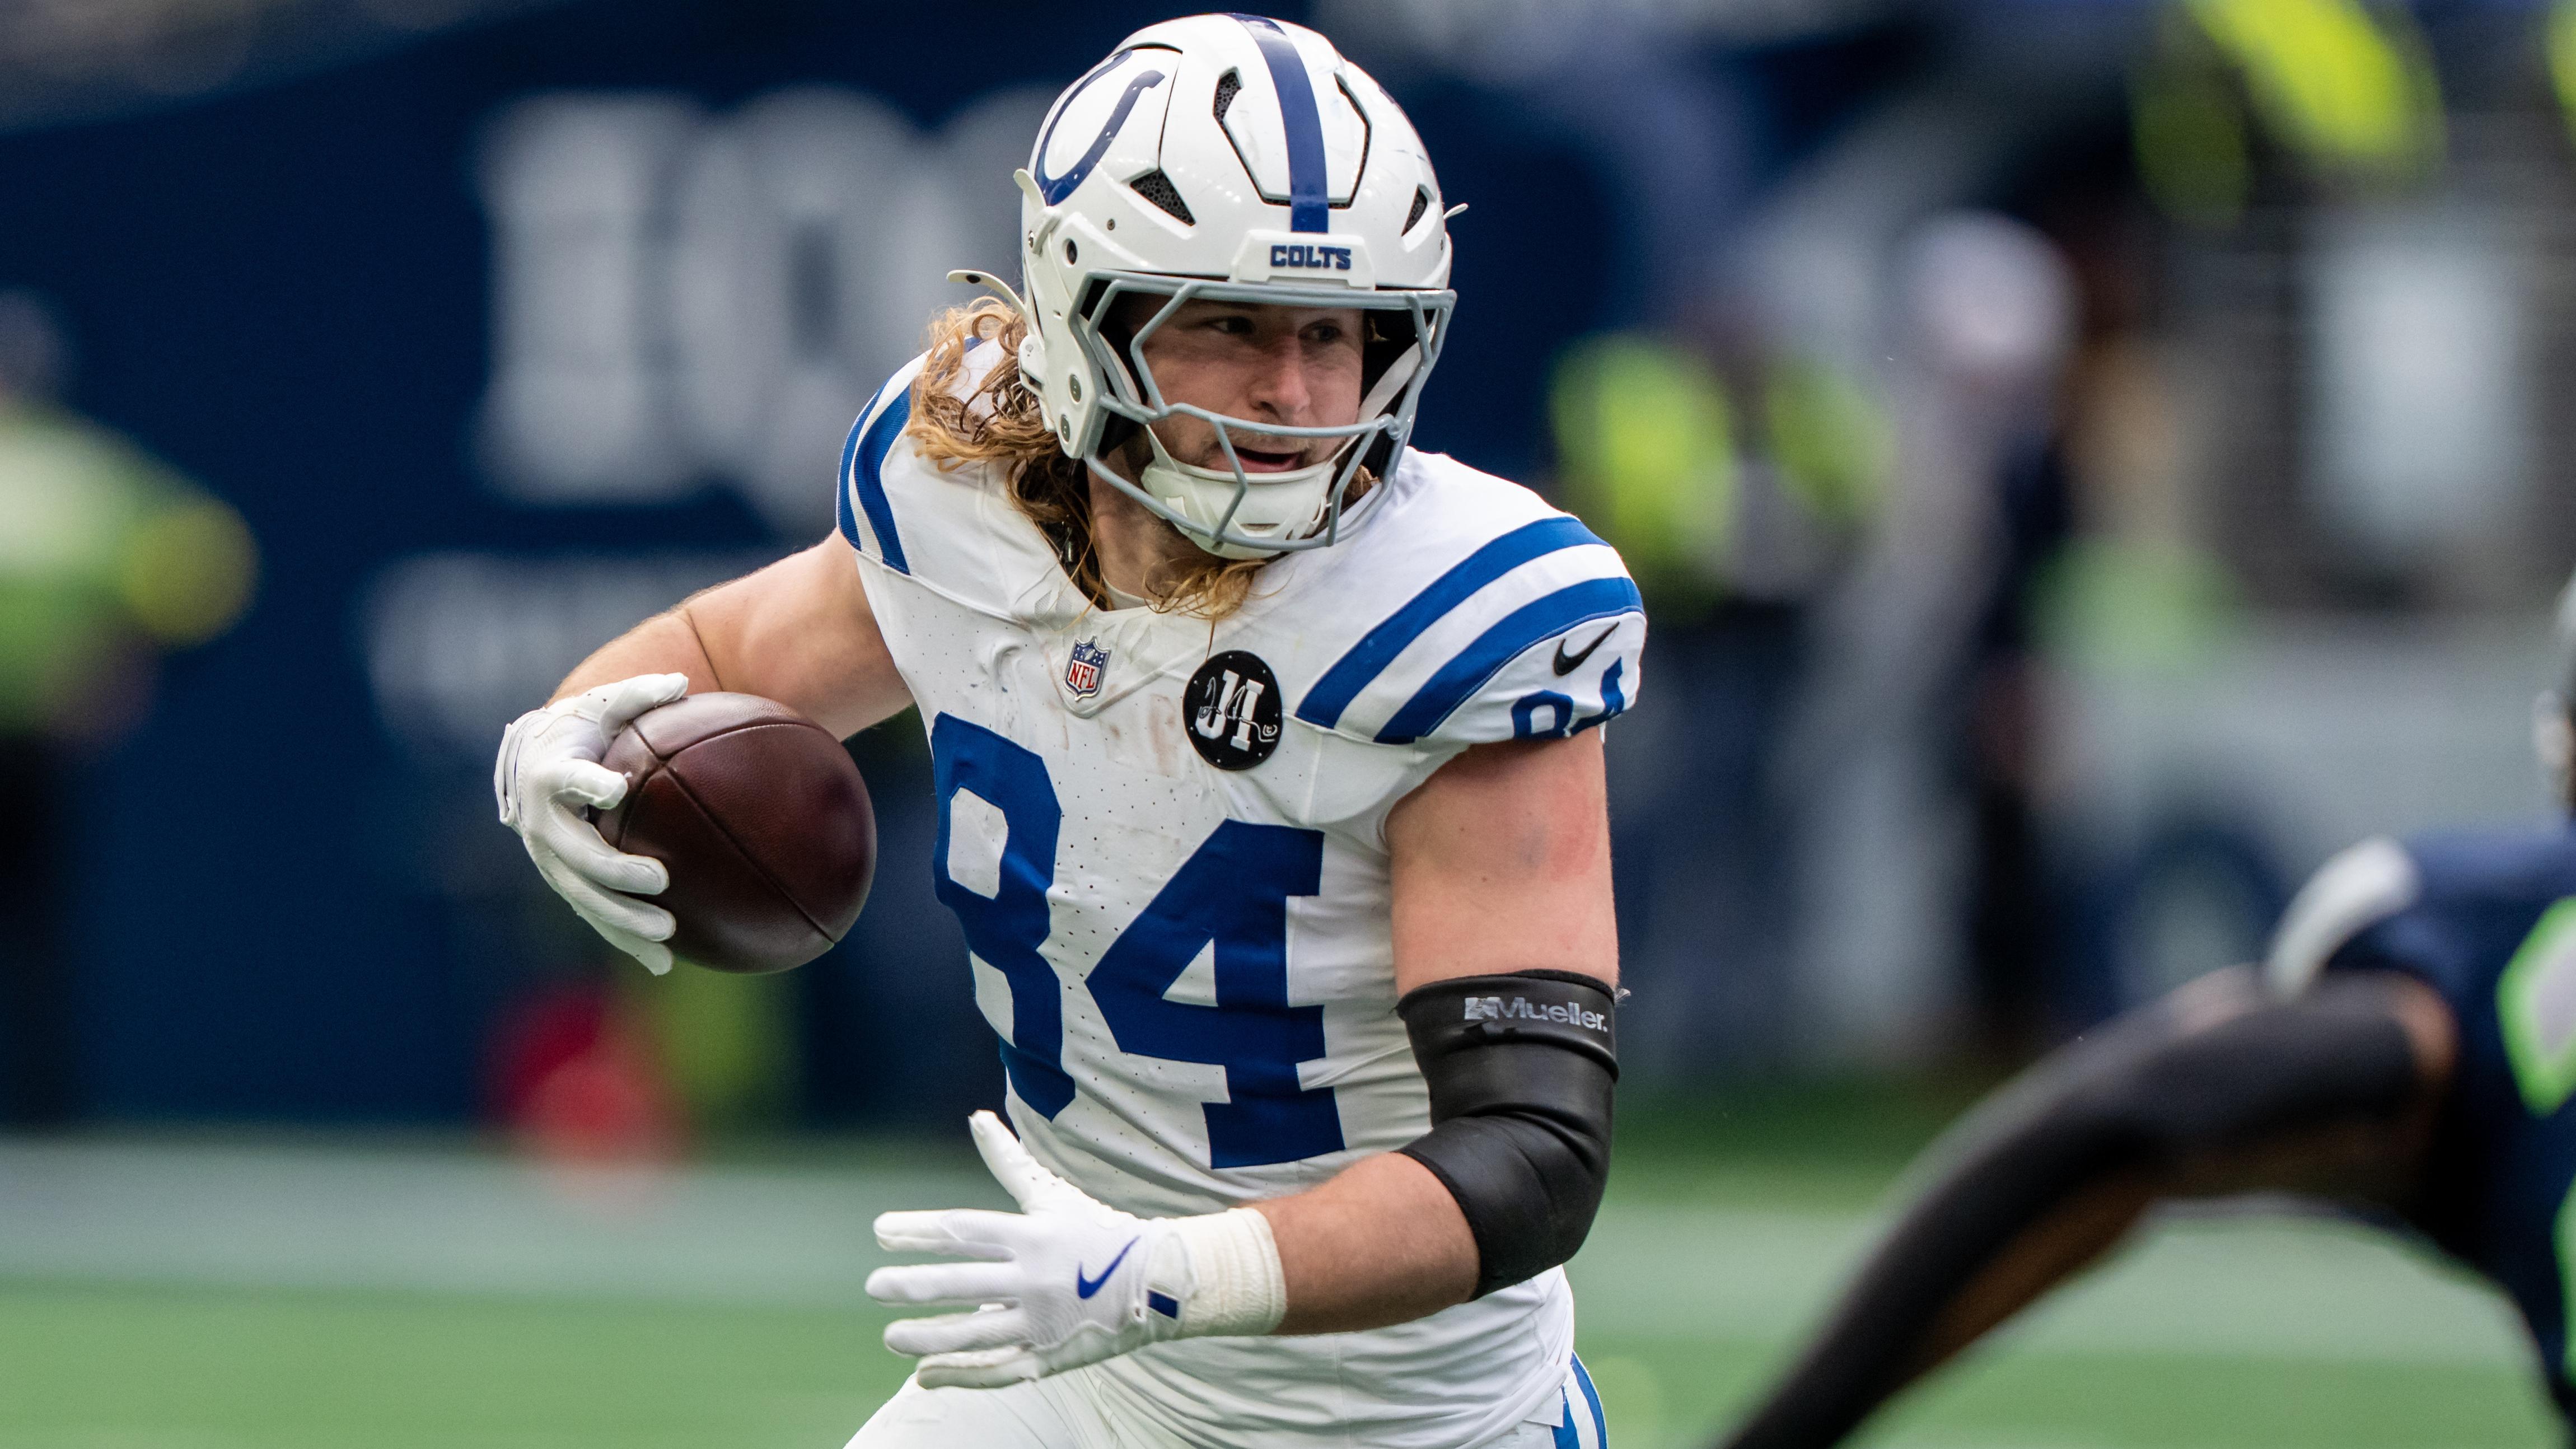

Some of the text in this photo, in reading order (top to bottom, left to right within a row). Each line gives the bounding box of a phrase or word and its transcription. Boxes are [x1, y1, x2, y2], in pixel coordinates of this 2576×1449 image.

[1270, 245, 1351, 270] COLTS
[1069, 662, 1095, 690] NFL
[931, 711, 1345, 1169] 84
